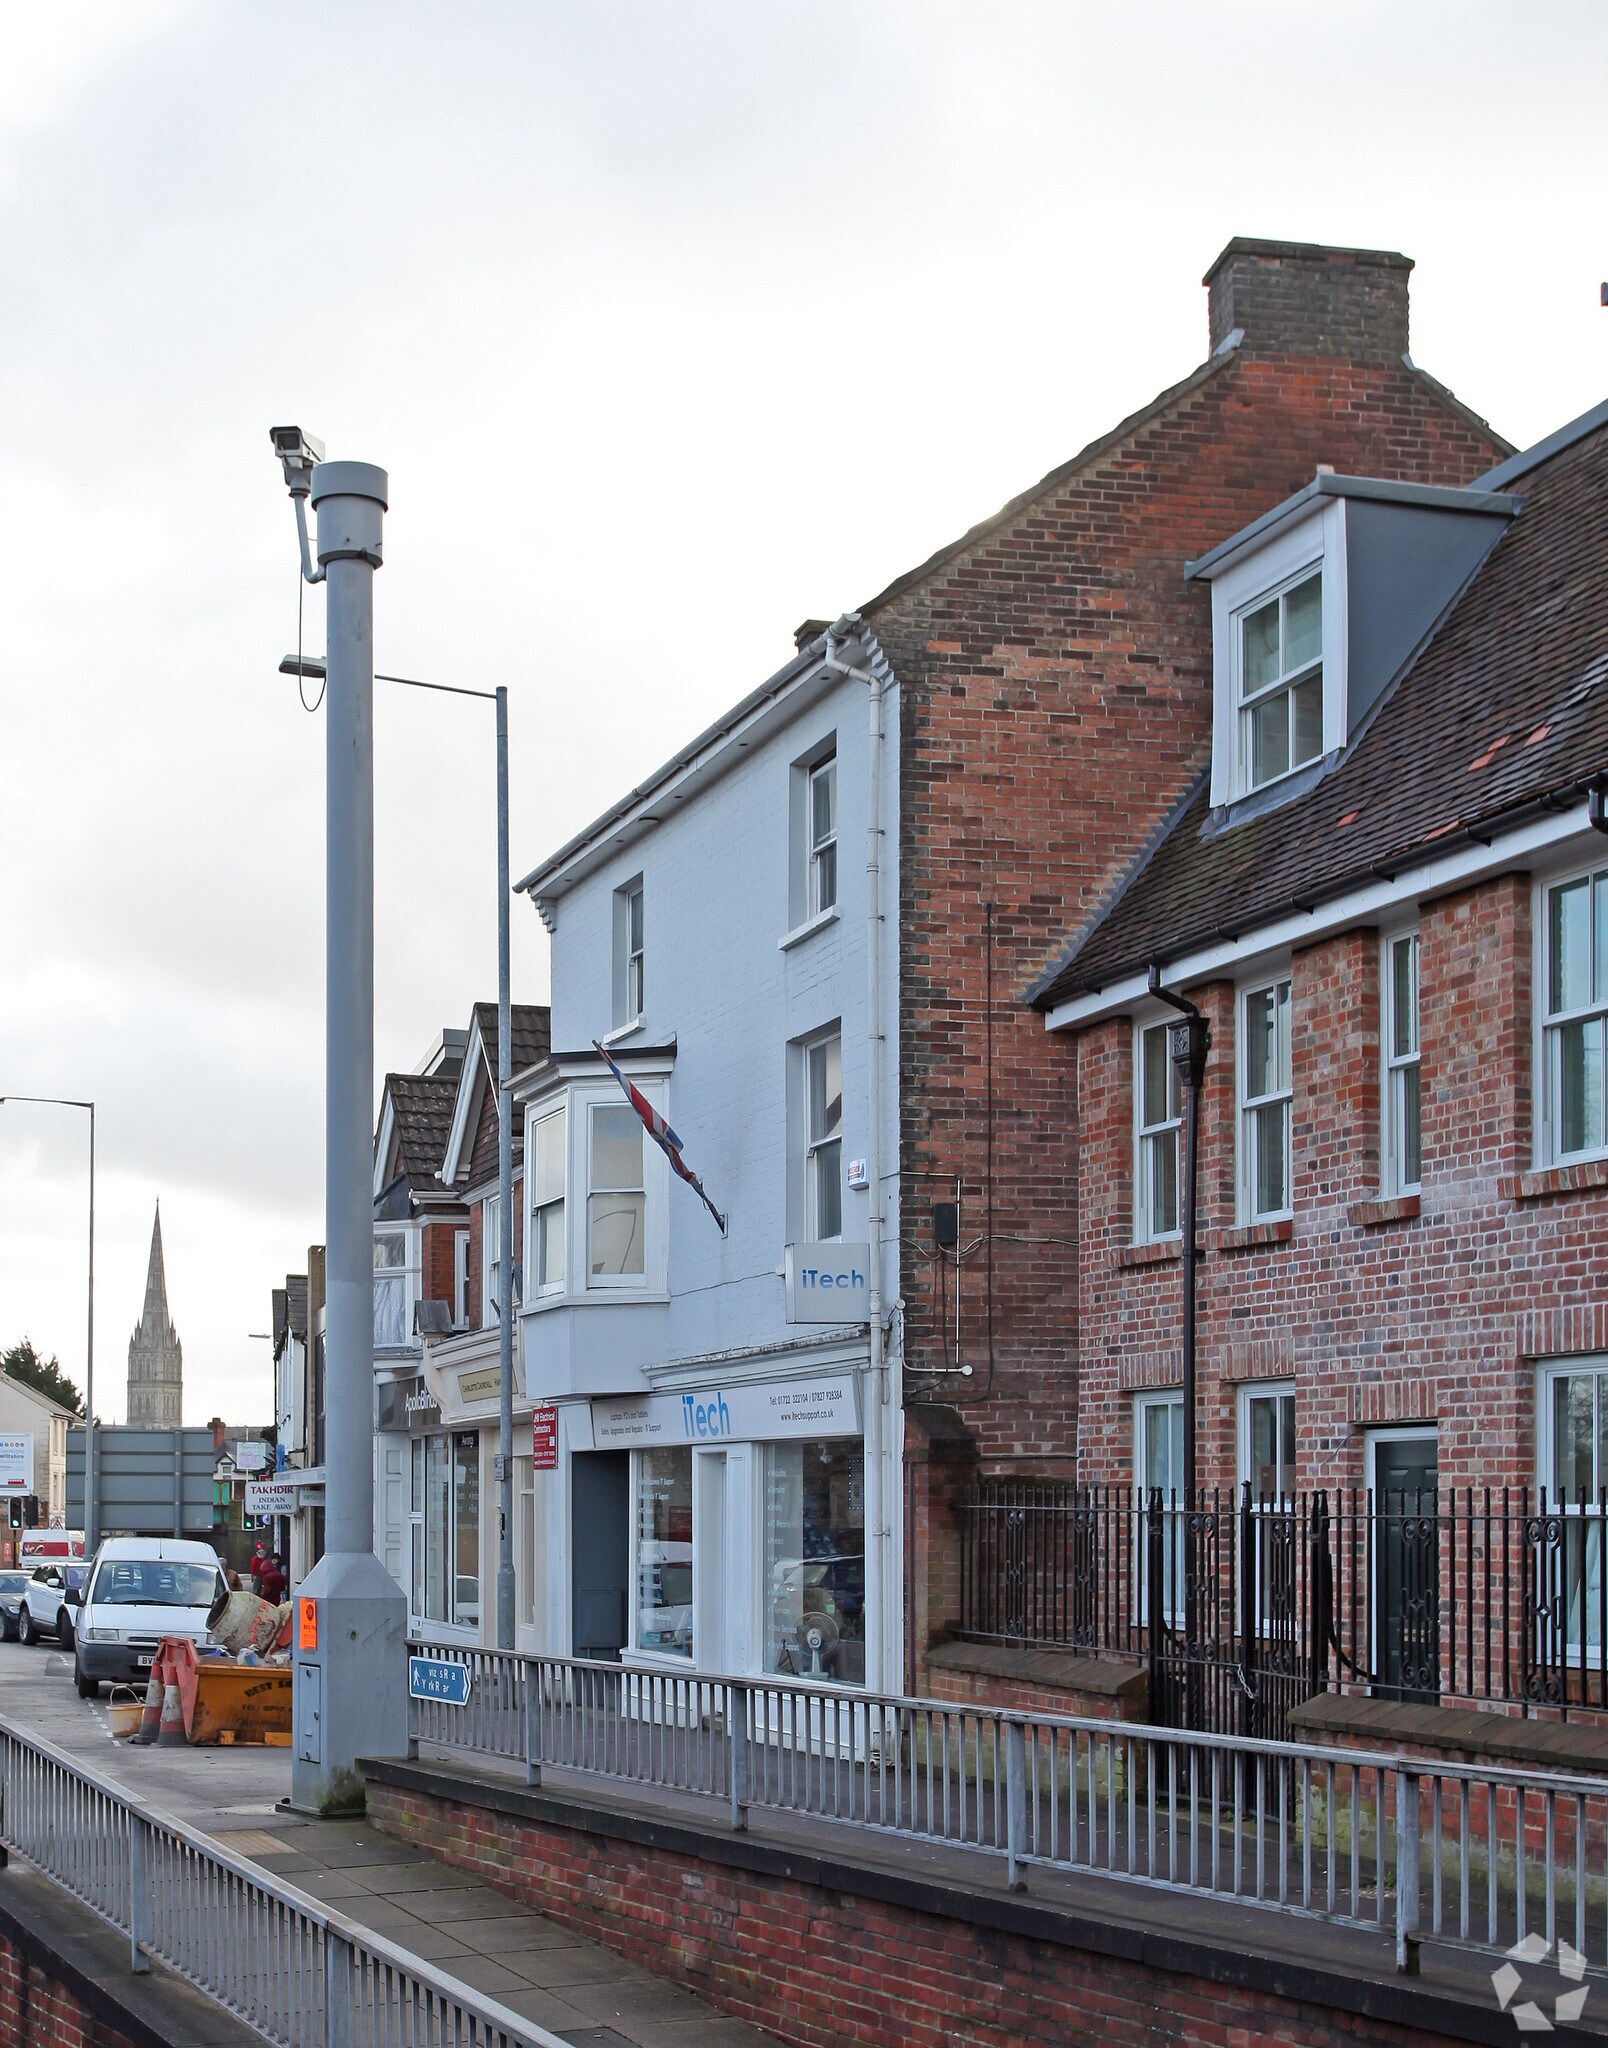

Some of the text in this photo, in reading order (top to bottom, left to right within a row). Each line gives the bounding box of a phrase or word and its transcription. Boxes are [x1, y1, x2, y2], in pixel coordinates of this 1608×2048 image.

[802, 1269, 864, 1288] iTech
[778, 1395, 791, 1405] 01722
[682, 1392, 731, 1437] iTech
[244, 1680, 292, 1697] BEST SK
